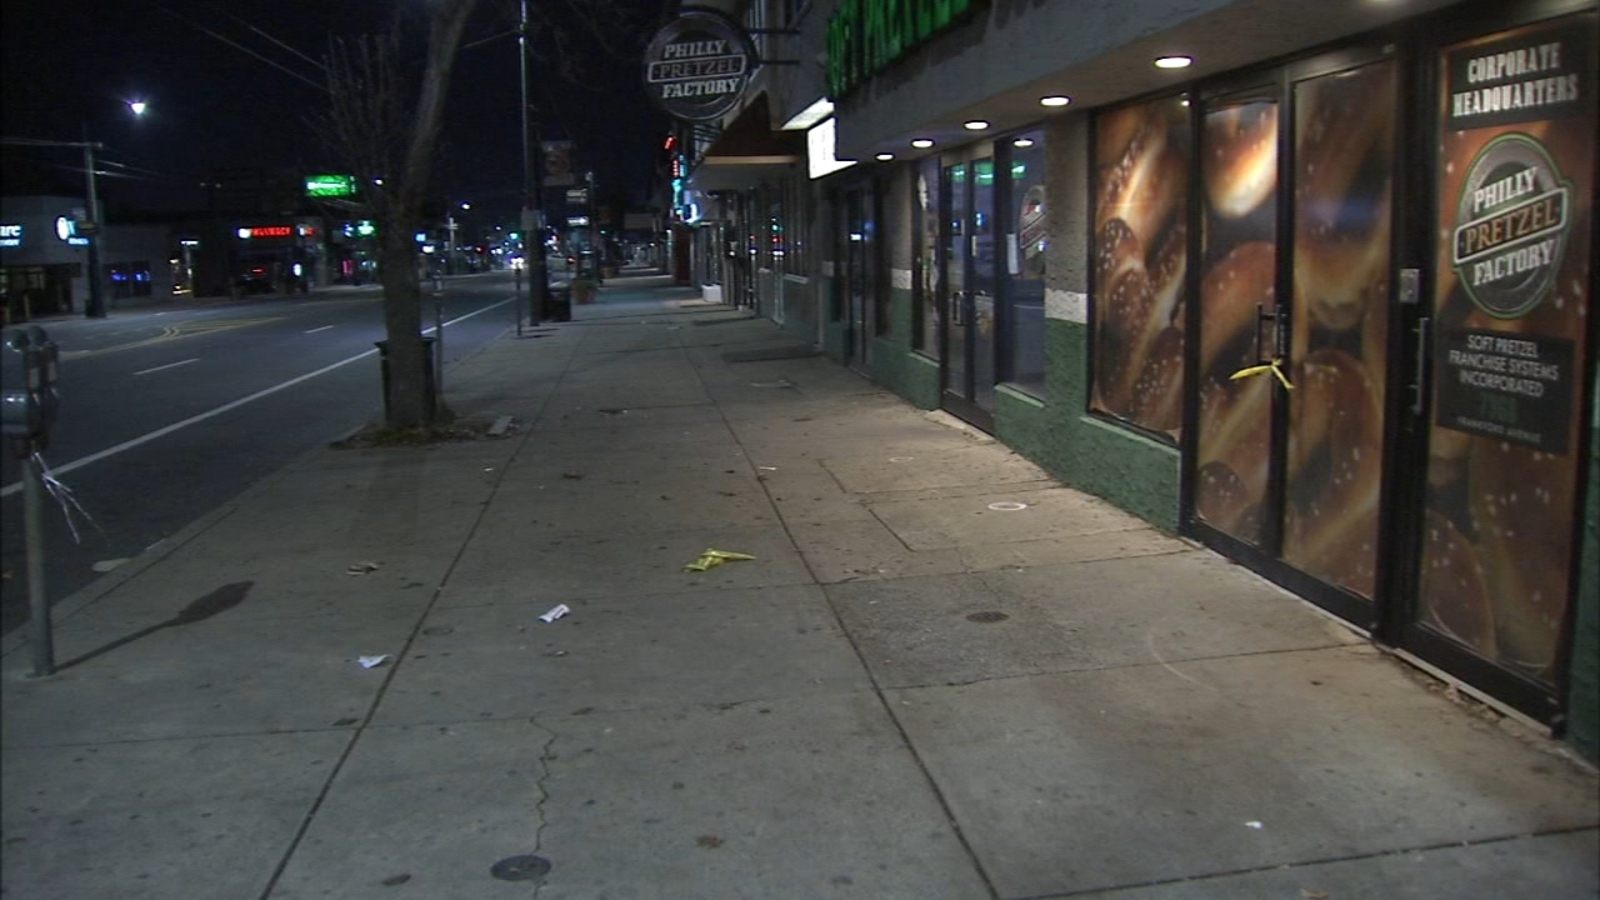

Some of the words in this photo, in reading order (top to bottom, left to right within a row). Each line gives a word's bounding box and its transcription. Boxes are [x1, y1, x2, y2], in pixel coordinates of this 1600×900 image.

[664, 39, 727, 59] PHILLY
[1468, 42, 1561, 84] CORPORATE
[659, 58, 739, 79] PRETZEL
[662, 77, 740, 99] FACTORY
[1453, 73, 1579, 118] HEADQUARTERS
[1473, 165, 1538, 213] PHILLY
[1464, 199, 1559, 255] PRETZEL
[1473, 240, 1555, 286] FACTORY
[1466, 333, 1495, 352] SOFT
[1495, 337, 1539, 359] PRETZEL
[1448, 349, 1507, 372] FRANCHISE
[1508, 357, 1560, 381] SYSTEMS
[1459, 369, 1545, 398] INCORPORATED
